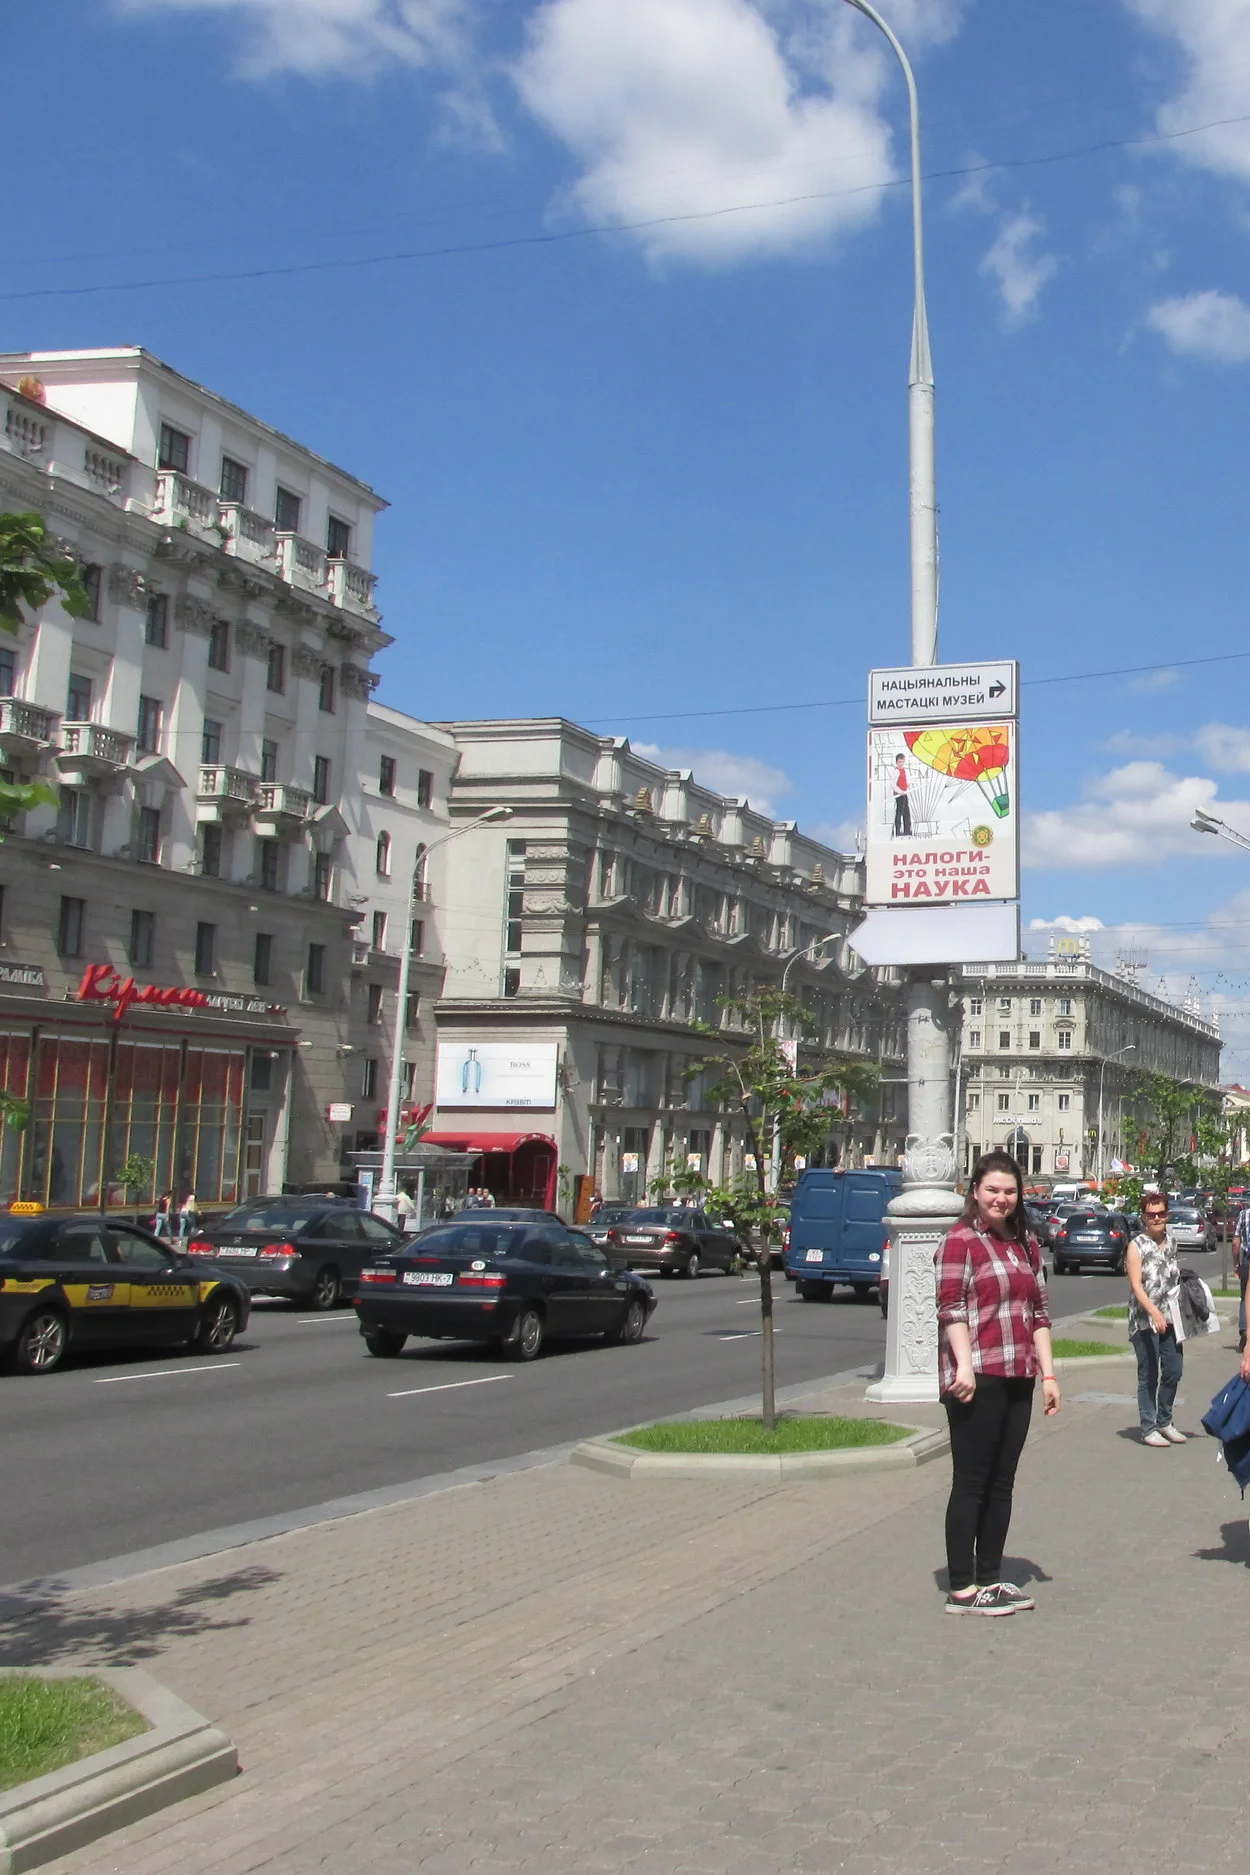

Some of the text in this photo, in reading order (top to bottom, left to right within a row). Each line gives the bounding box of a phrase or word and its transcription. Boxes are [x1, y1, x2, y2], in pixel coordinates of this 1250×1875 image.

[881, 675, 981, 692] НАЦЫЯНАЛЬНЫ
[877, 691, 985, 711] МАСТАЦКІ МУЗЕЙ
[893, 865, 990, 879] это наша
[891, 878, 991, 899] НАУКА
